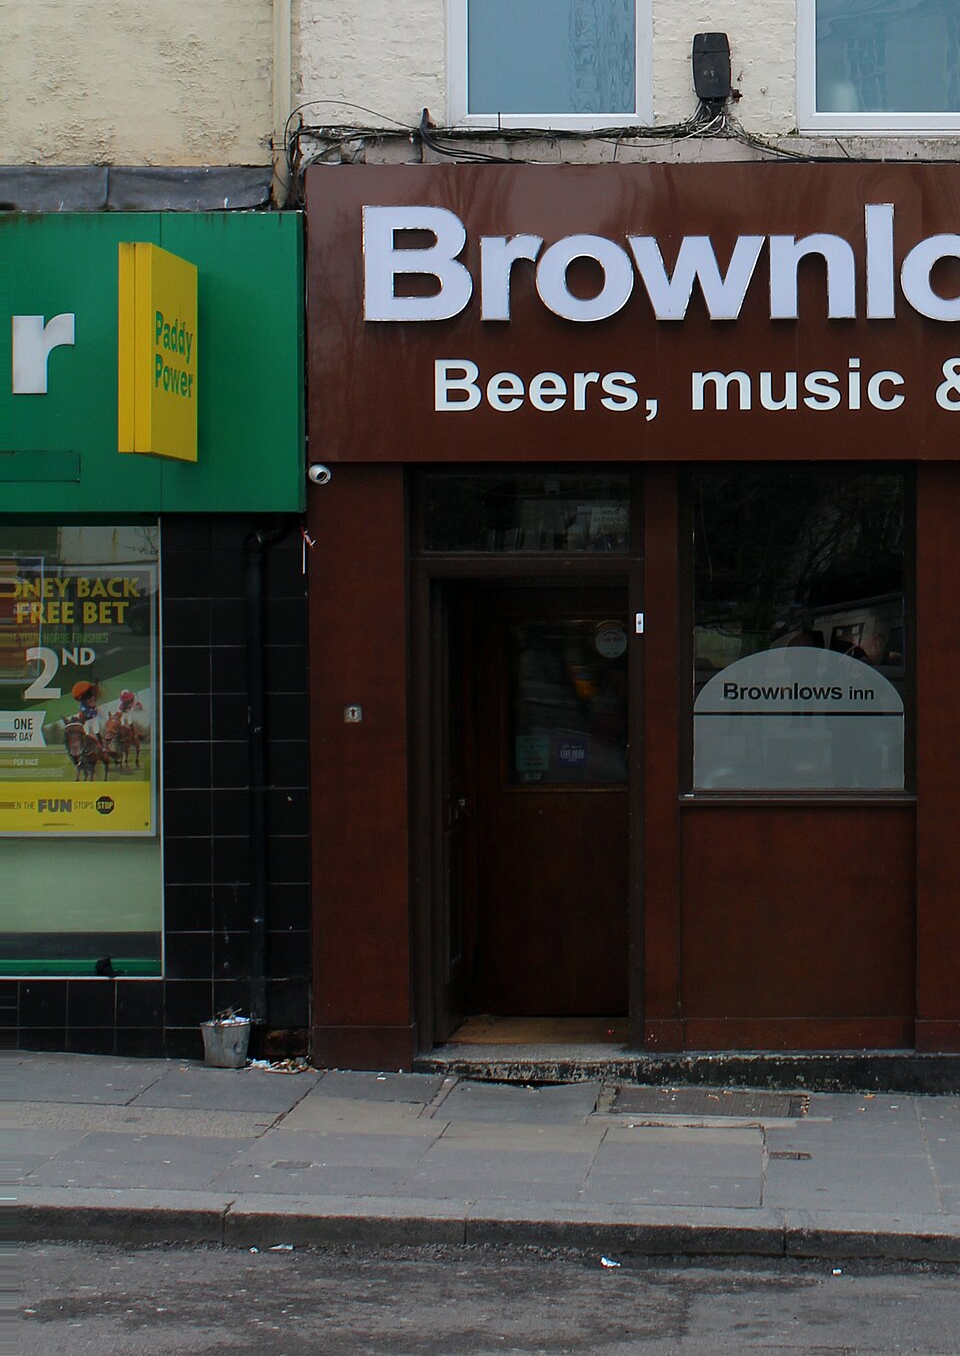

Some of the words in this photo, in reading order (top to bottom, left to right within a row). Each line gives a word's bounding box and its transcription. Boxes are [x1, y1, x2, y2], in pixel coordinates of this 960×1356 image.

[155, 310, 194, 365] Paddy
[155, 353, 194, 399] Power
[433, 358, 660, 422] Beers,
[691, 357, 907, 412] music
[77, 577, 141, 598] BACK
[16, 601, 75, 624] FREE
[83, 601, 130, 624] BET
[723, 682, 843, 701] Brownlows
[849, 685, 875, 701] inn
[13, 718, 34, 731] ONE
[19, 732, 34, 742] DAY
[24, 800, 35, 810] THE
[37, 798, 73, 813] FUN
[73, 800, 95, 810] STOPS
[96, 800, 114, 810] STOP
